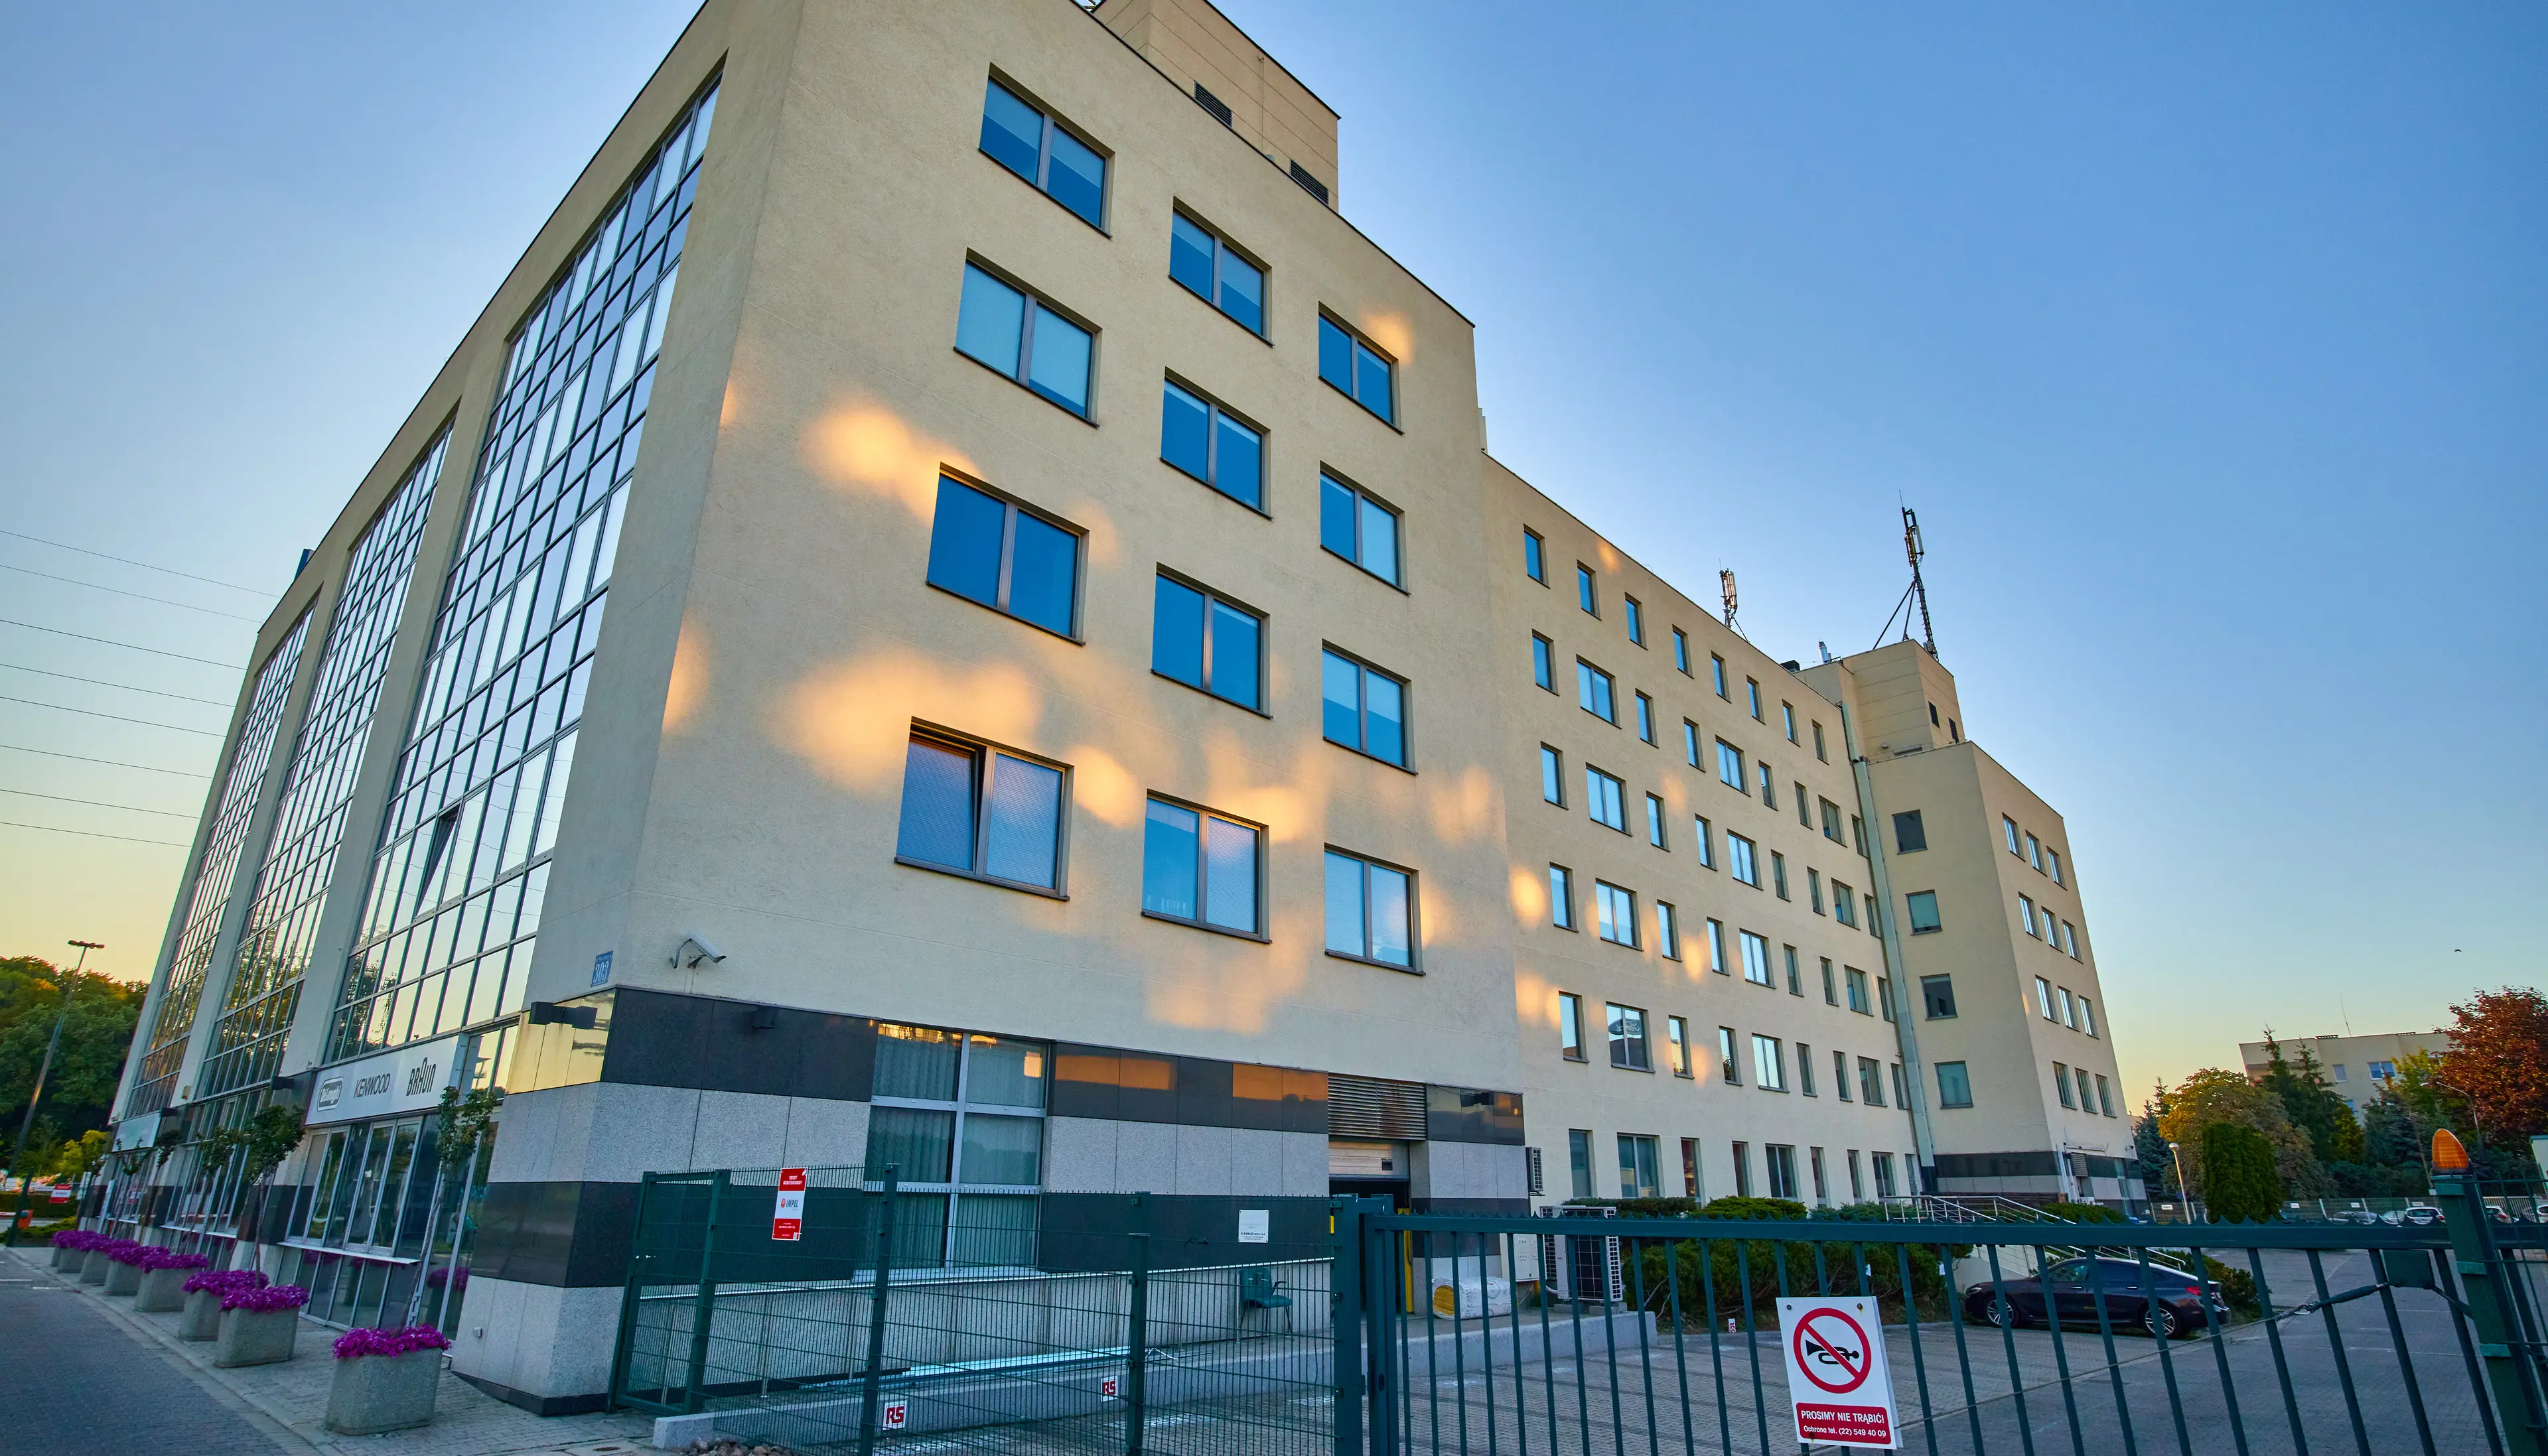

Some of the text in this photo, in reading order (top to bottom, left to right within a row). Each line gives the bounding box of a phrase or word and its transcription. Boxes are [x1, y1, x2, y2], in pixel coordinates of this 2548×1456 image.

[593, 961, 608, 982] 303
[353, 1073, 391, 1098] KENWOOD
[406, 1057, 437, 1096] BRAUN
[1102, 1380, 1115, 1395] RS
[886, 1406, 904, 1424] RS
[1801, 1410, 1884, 1425] PROSIMY NIE TRĄBIĆ!
[1839, 1427, 1852, 1436] (22)
